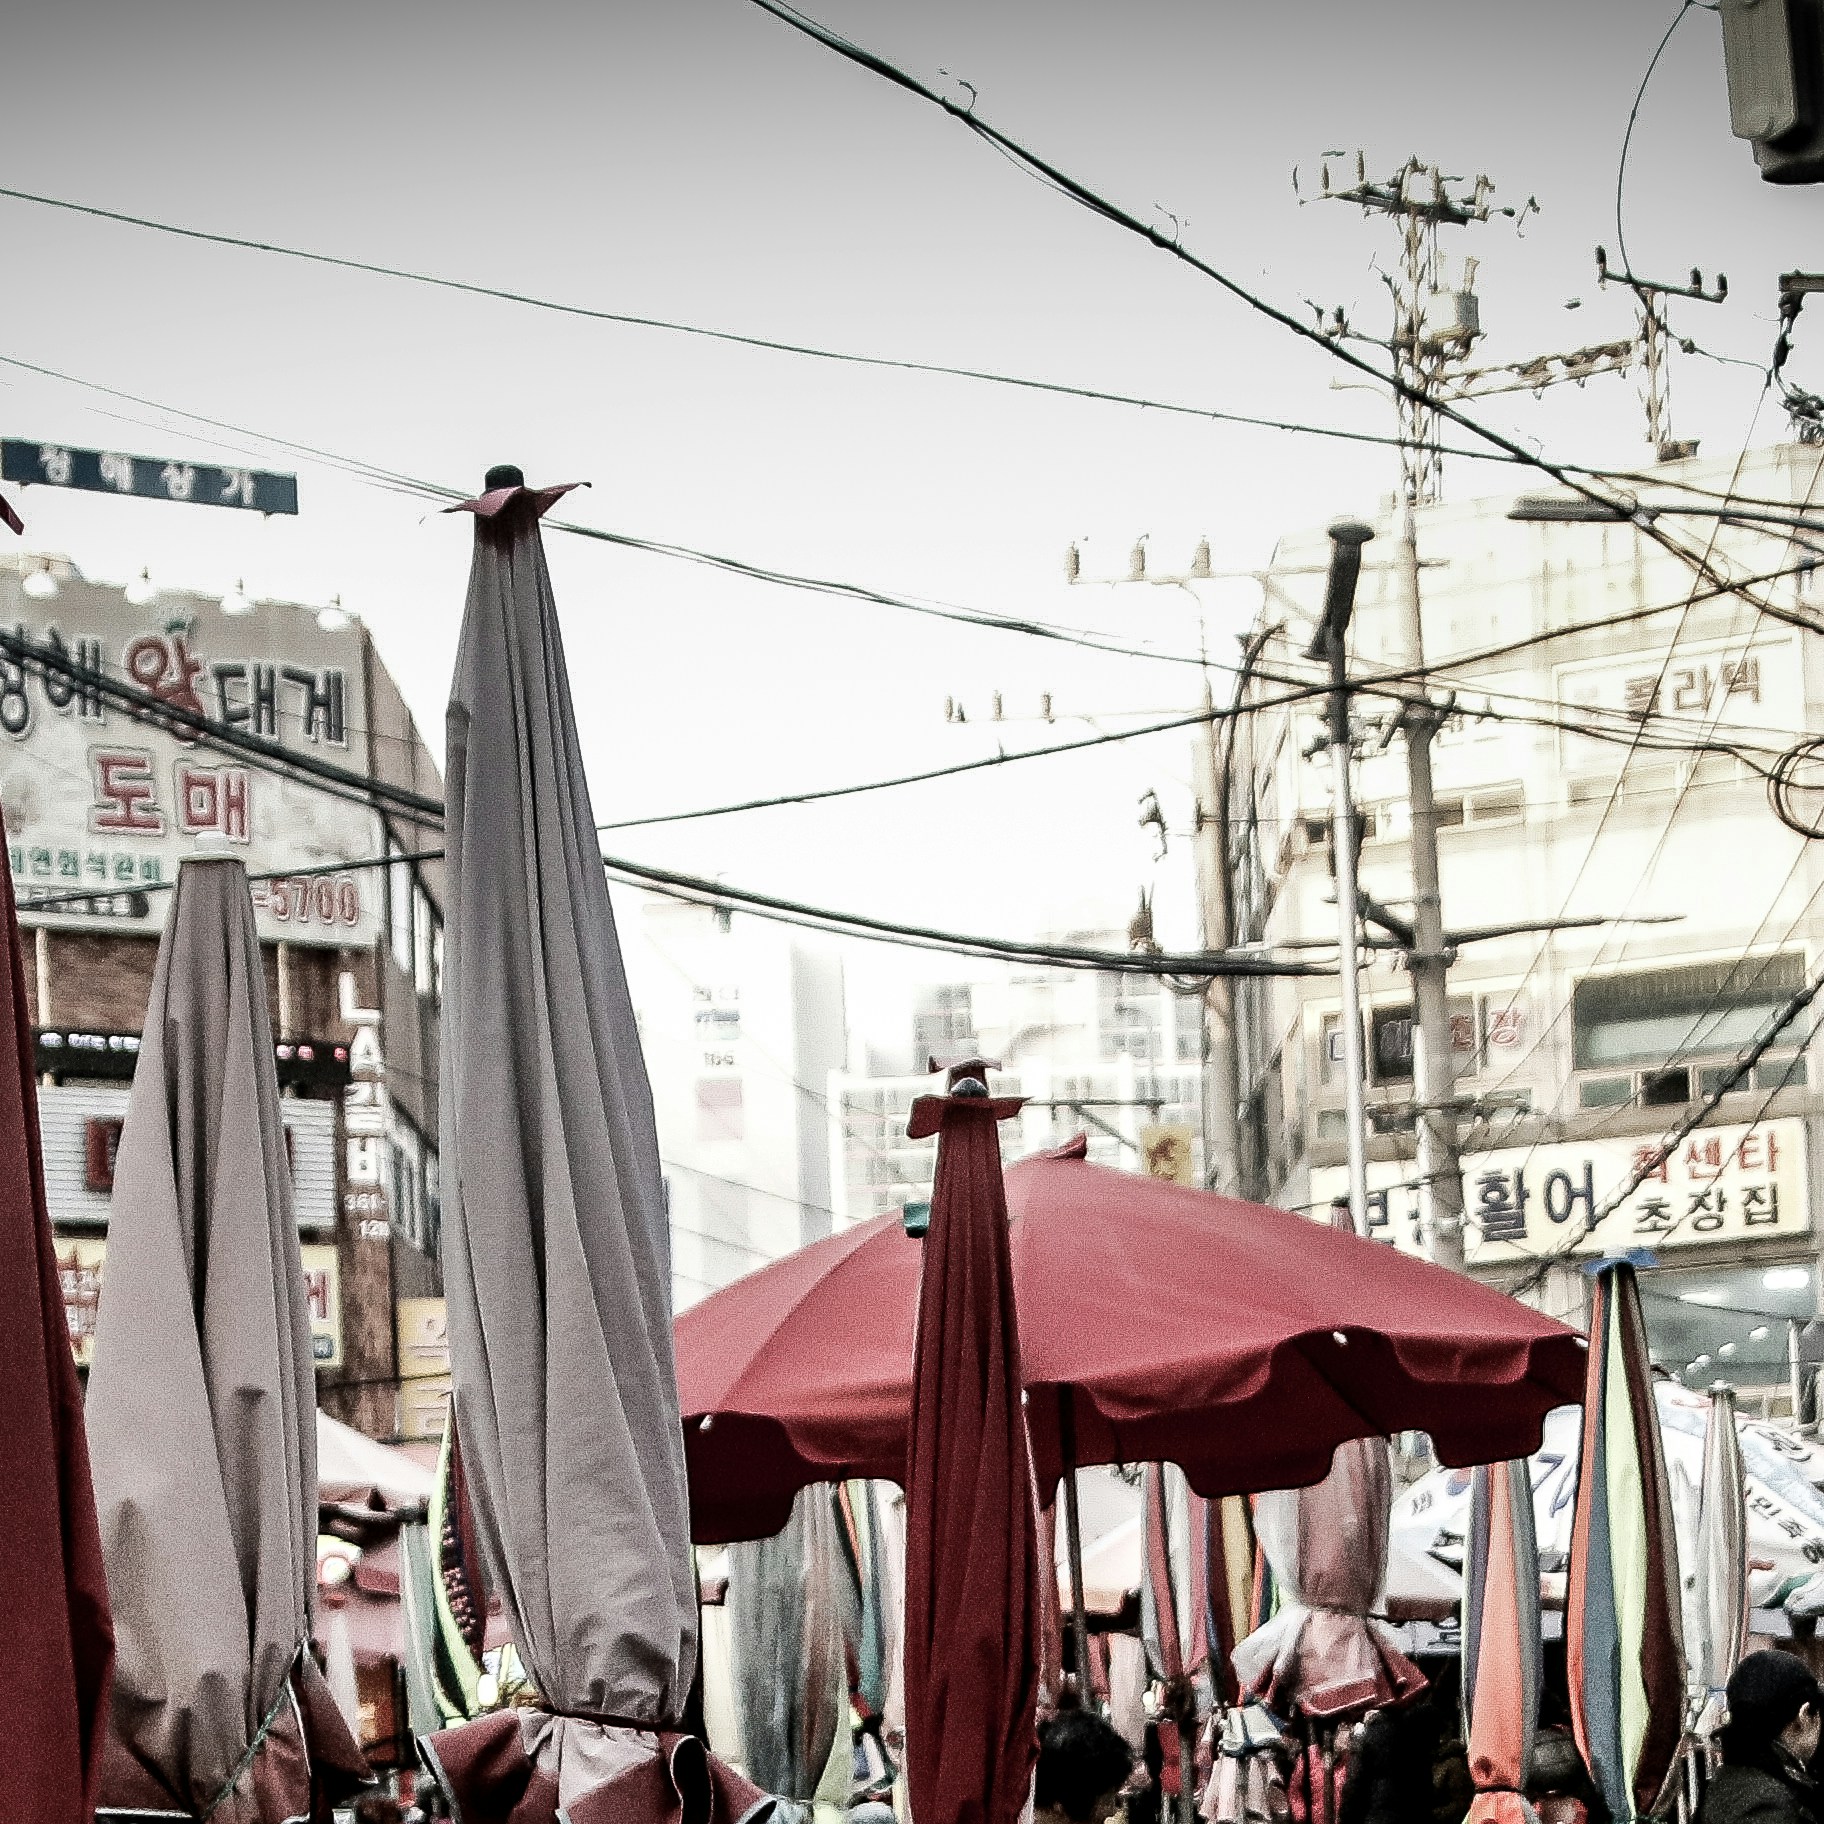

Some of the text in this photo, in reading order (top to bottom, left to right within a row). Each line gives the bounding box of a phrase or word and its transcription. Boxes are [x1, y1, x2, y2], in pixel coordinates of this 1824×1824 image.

[94, 752, 252, 838] 도매
[1475, 1160, 1597, 1243] 활어
[1632, 1181, 1781, 1233] 초장집
